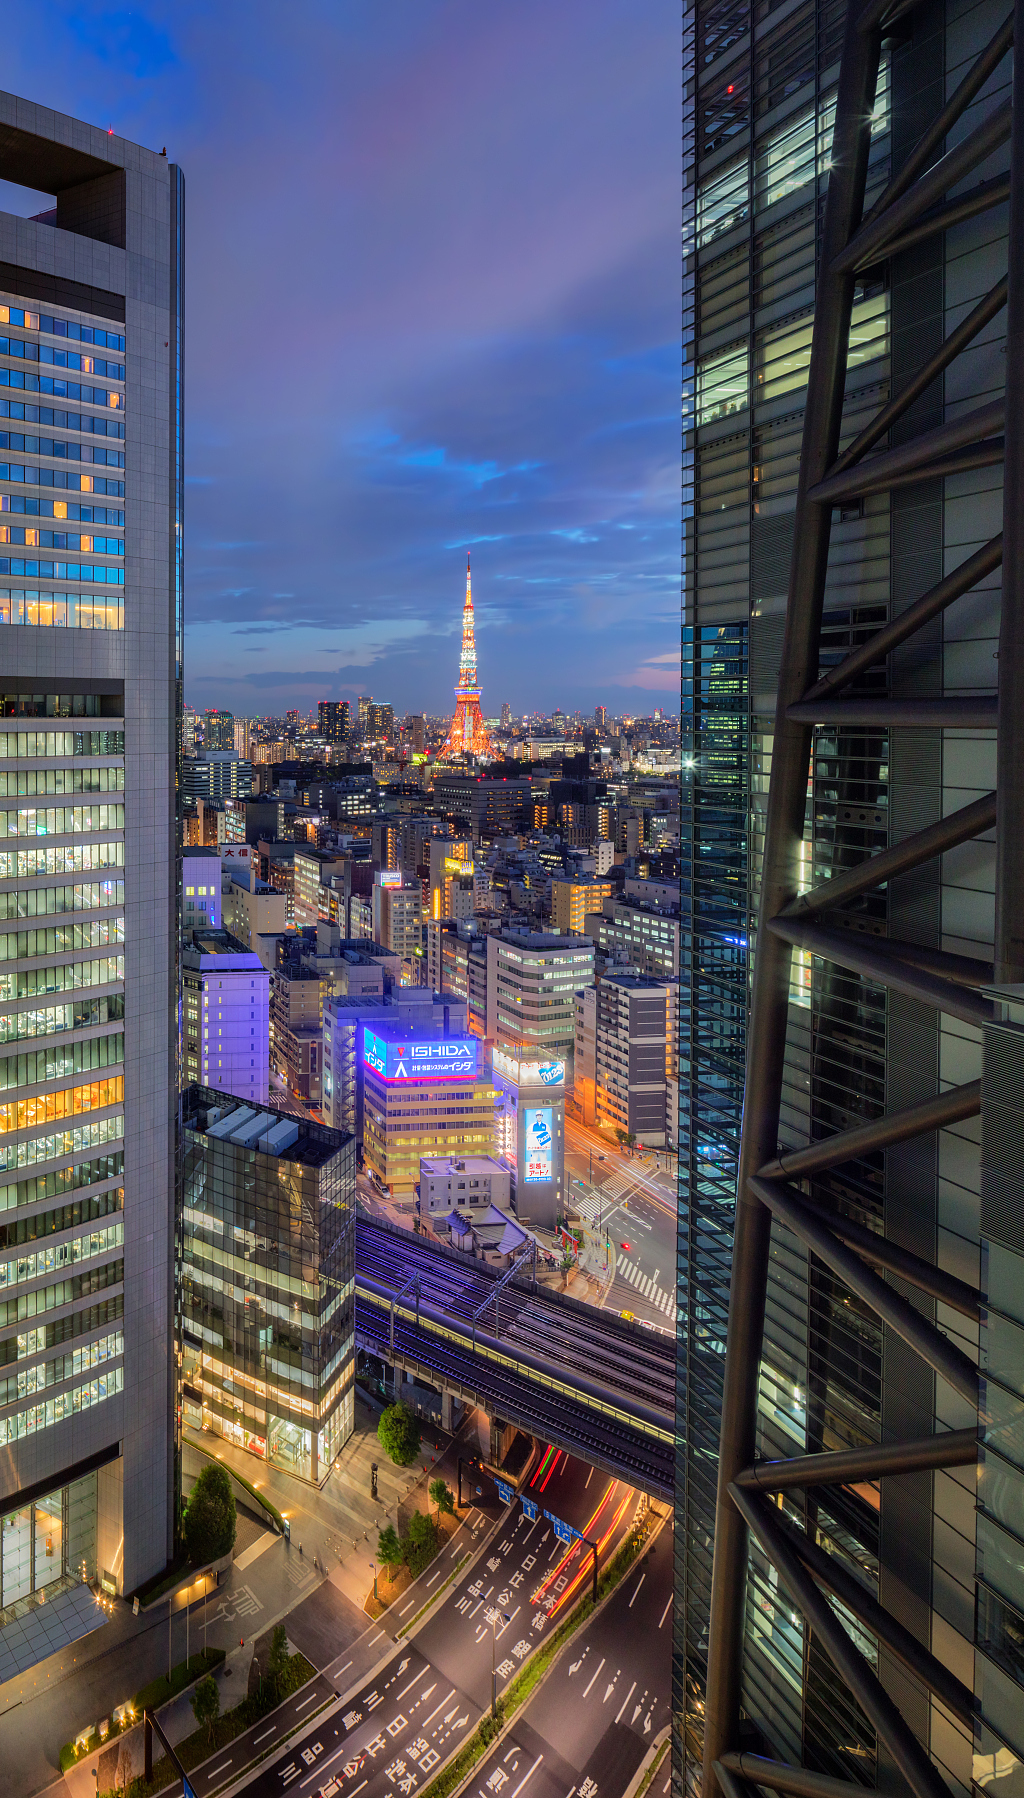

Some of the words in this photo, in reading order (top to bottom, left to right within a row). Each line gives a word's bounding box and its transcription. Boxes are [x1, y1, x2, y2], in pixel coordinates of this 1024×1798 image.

[225, 848, 248, 858] 大信
[364, 1051, 386, 1072] イシダ
[411, 1045, 471, 1057] ISHIDA
[226, 1586, 260, 1617] STOP
[308, 1713, 409, 1798] 日比谷通
